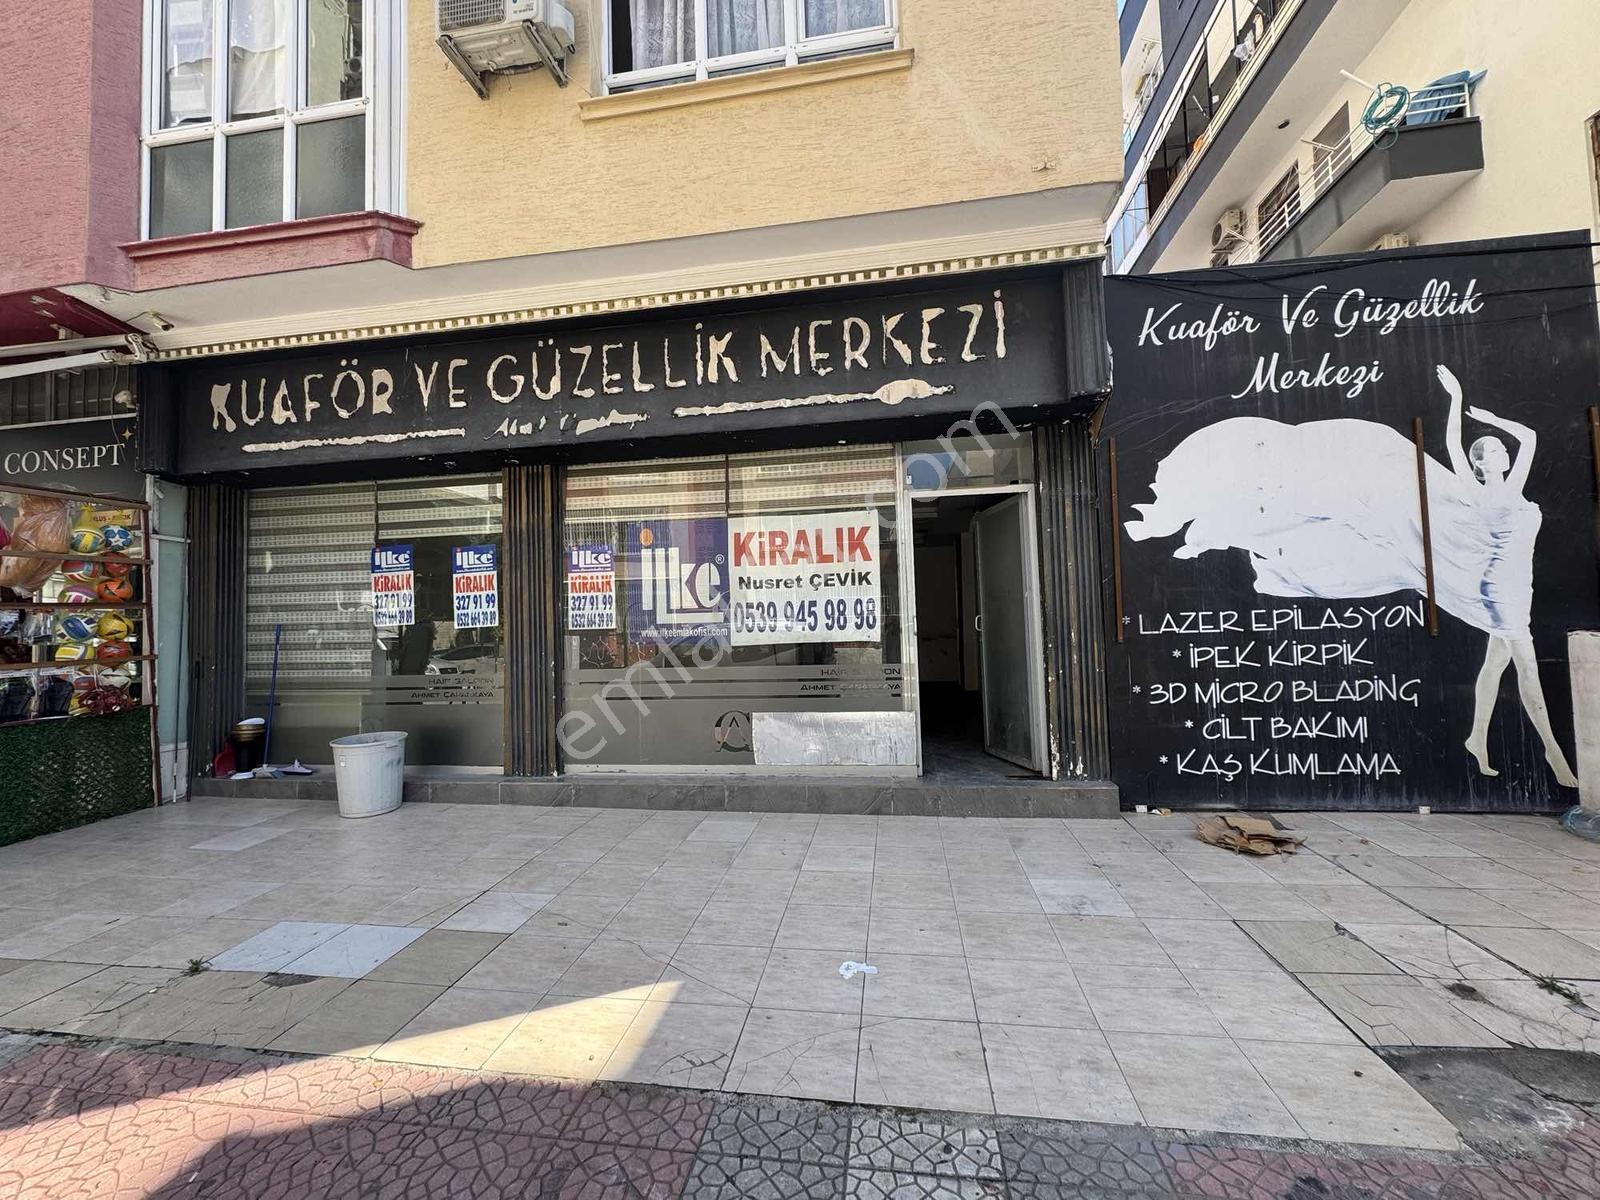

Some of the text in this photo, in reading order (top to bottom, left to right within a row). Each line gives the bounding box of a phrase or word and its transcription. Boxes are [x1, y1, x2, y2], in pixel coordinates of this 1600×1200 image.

[1138, 278, 1485, 352] Kuaför Ve Güzellik
[209, 358, 394, 433] KUAFÖR
[414, 358, 468, 413] VE
[487, 322, 741, 404] GÜZELLİK
[759, 289, 1007, 378] MERKEZİ
[1230, 352, 1384, 399] Merkezi
[4, 443, 125, 475] CONSEPT
[738, 569, 873, 591] Nusret ÇEVİK
[374, 592, 413, 610] 327 91 99
[456, 593, 496, 611] 327 91 99
[571, 594, 613, 611] 327 91 99
[734, 597, 877, 634] 0539 945 98 98
[1138, 599, 1426, 634] LAZER EPİLASYON
[456, 610, 497, 627] 0532 664 39 89
[571, 612, 614, 628] 0532 664 39 89
[1188, 637, 1375, 669] İPEK KİRPİK
[1149, 673, 1422, 709] 3D MİCRO BLADİNG
[1202, 711, 1368, 744] CİLT BAKIMI
[1176, 747, 1402, 782] KAŞ KUMLAMA
